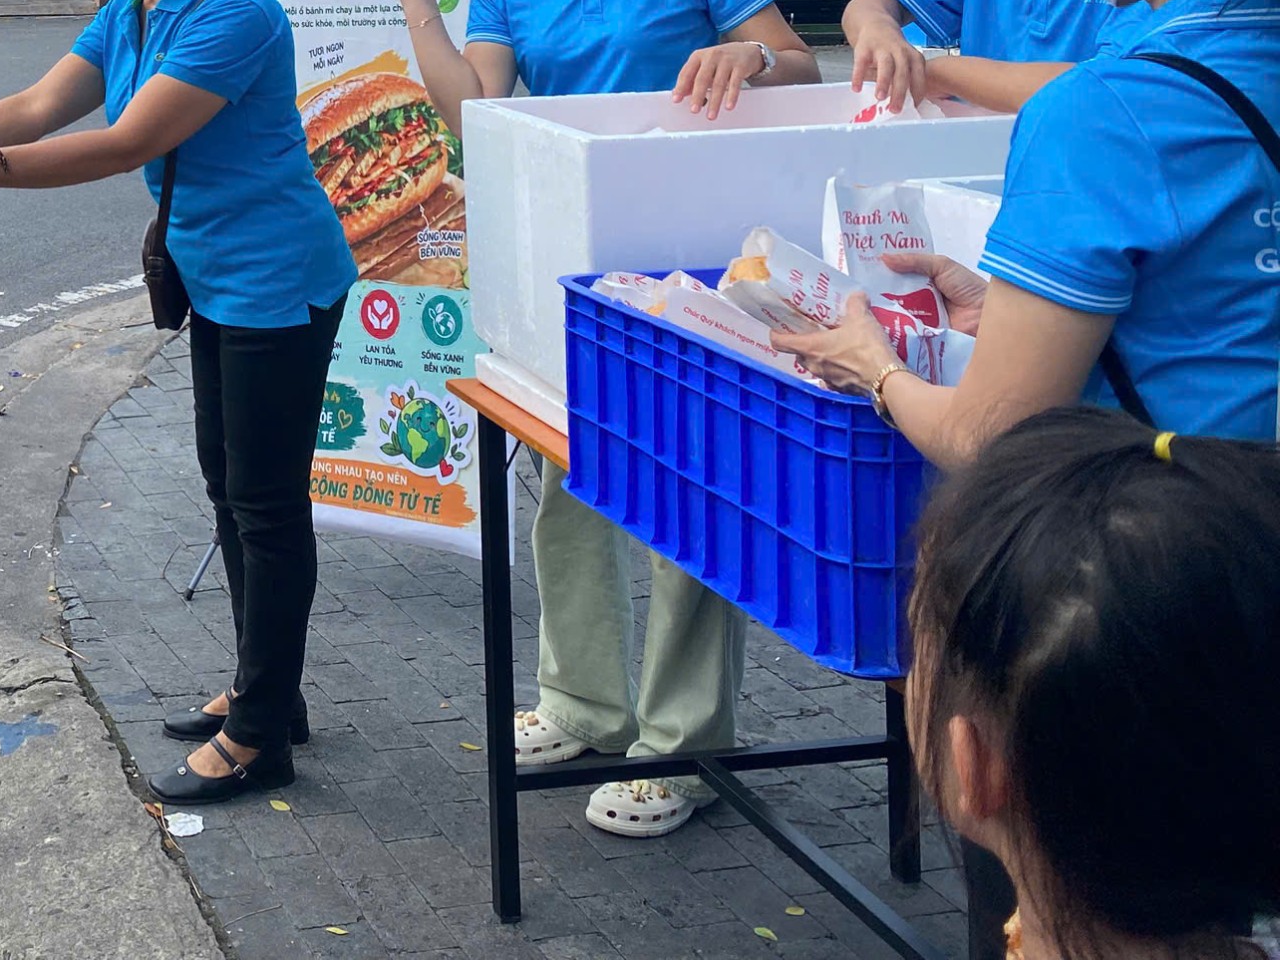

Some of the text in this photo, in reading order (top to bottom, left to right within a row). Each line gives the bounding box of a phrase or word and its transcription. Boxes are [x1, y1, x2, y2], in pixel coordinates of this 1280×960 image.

[306, 5, 324, 15] bánh
[336, 5, 352, 16] chay
[363, 5, 378, 14] một
[380, 4, 391, 14] lựa
[291, 19, 300, 28] ho
[302, 19, 314, 28] sức
[337, 18, 350, 27] môi
[351, 19, 376, 28] trường
[377, 18, 386, 26] và
[388, 18, 407, 27] cộng
[308, 41, 345, 58] TƯƠI NGON
[313, 54, 344, 71] MỖI NGÀY
[842, 208, 884, 226] Bánh
[418, 229, 464, 243] SỐNG XANH
[842, 232, 876, 252] Việt
[880, 231, 927, 250] Nam
[420, 243, 461, 258] BỀN VỮNG
[683, 306, 778, 358] Chúc Quý khách ngon miệng
[365, 344, 396, 355] LAN TỎA
[421, 350, 465, 363] SỐNG XANH
[359, 355, 404, 369] YÊU THƯƠNG
[424, 362, 462, 375] BỀN VỮNG
[320, 407, 333, 424] ỎE
[312, 457, 408, 486] ÙNG NHAU TẠO NÊN
[309, 475, 442, 515] CỘNG ĐỒNG TỬ TẾ
